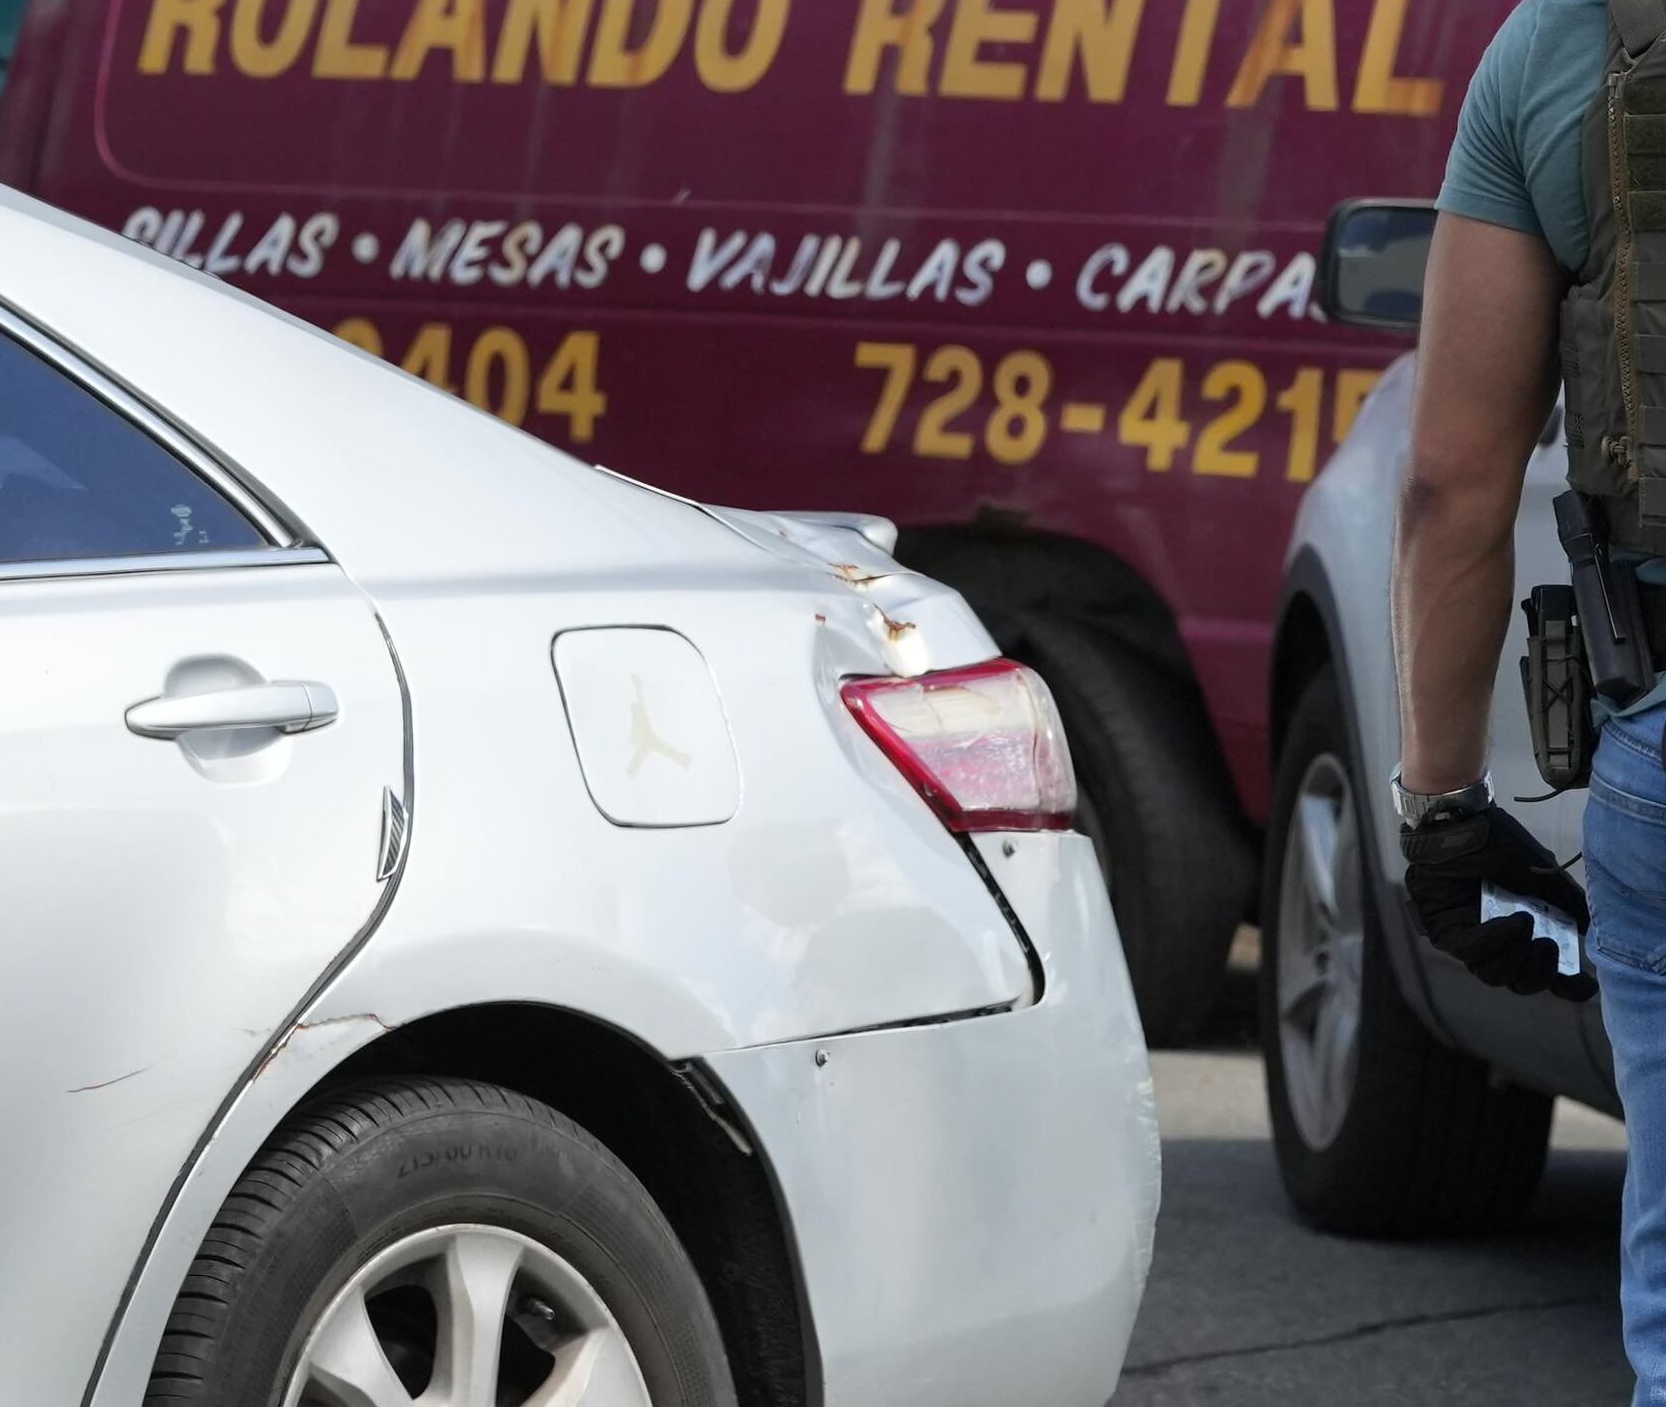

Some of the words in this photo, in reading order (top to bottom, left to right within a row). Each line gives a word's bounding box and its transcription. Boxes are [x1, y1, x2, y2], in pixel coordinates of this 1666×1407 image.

[389, 217, 625, 289] MESAS
[686, 227, 1007, 306] VAJILLAS
[1076, 242, 1328, 325] CARPA
